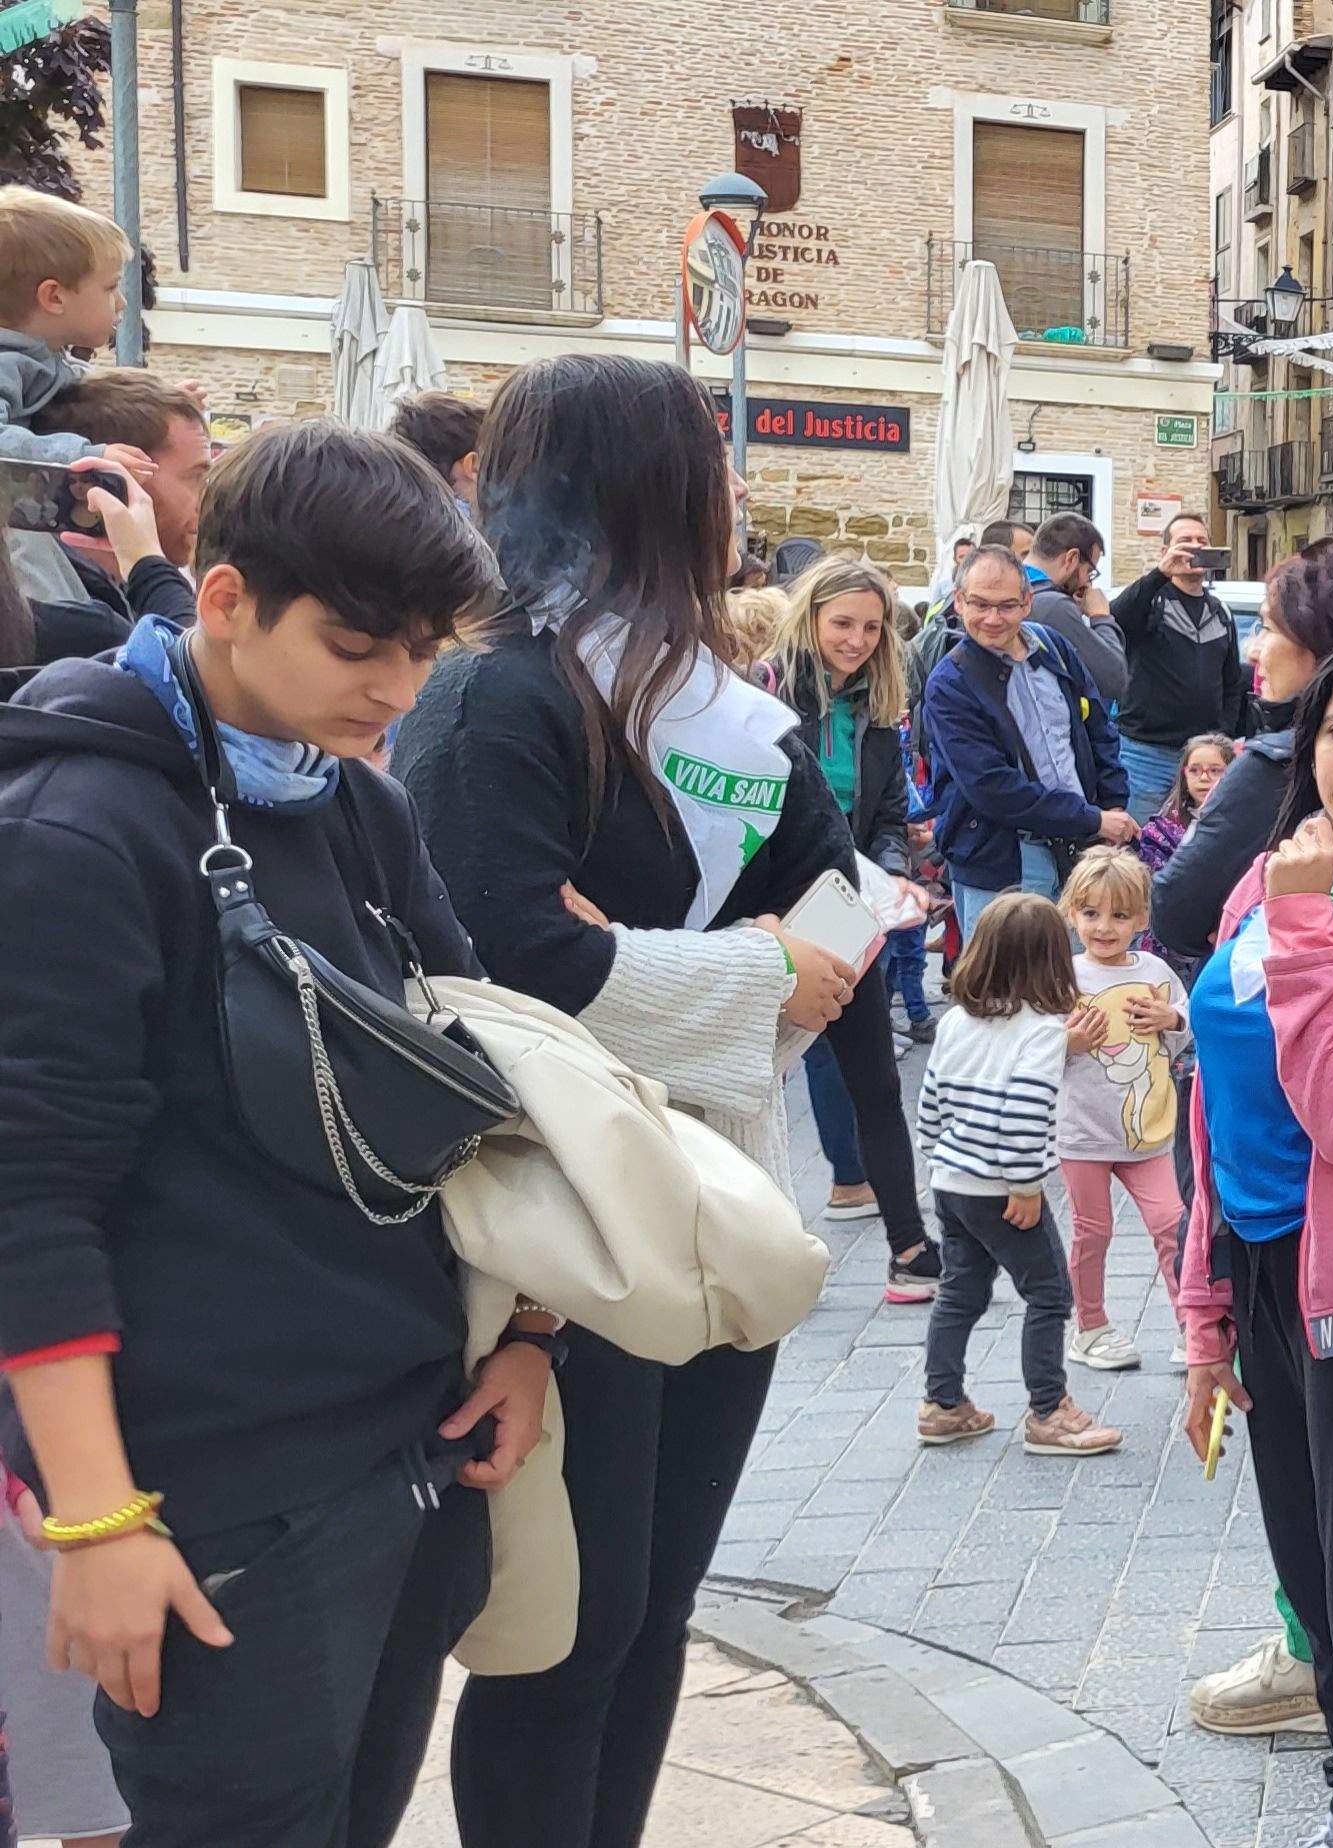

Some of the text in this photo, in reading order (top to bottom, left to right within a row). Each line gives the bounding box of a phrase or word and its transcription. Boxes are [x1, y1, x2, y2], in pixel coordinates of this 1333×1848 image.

[750, 243, 840, 265] USTICIA
[756, 266, 784, 283] DE
[744, 289, 819, 310] RAGON
[755, 408, 794, 435] del
[803, 410, 900, 442] Justicia
[674, 759, 727, 801] VIVA
[730, 779, 776, 807] SAN
